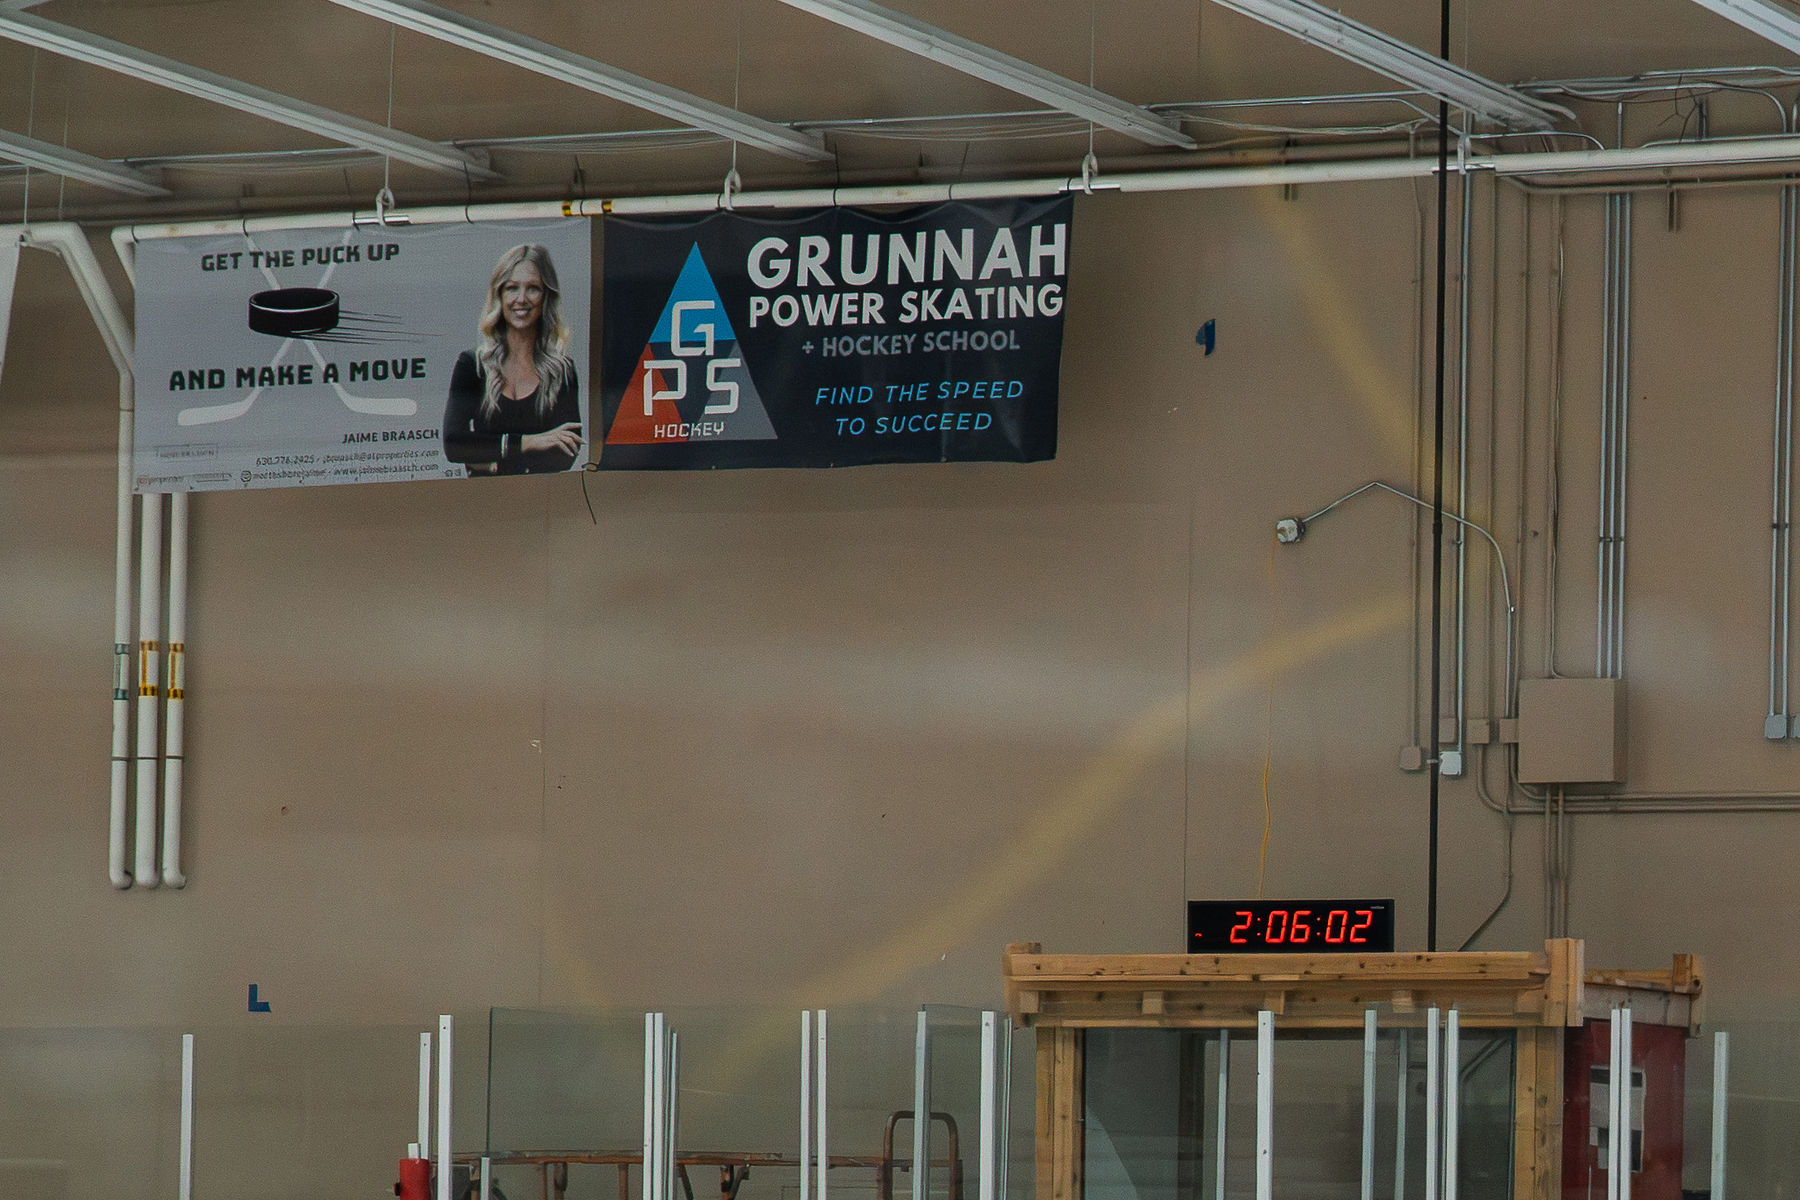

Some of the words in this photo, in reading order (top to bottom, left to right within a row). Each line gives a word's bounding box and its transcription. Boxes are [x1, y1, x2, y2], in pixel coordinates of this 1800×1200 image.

[201, 253, 242, 271] GET
[249, 250, 295, 268] THE
[302, 245, 360, 266] PUCK
[368, 243, 400, 262] UP
[747, 223, 1067, 290] GRUNNAH
[749, 293, 885, 328] POWER
[899, 283, 1063, 323] SKATING
[671, 301, 715, 357] G
[822, 334, 918, 357] HOCKEY
[923, 330, 1020, 352] SCHOOL
[169, 367, 225, 391] AND
[236, 363, 313, 388] MAKE
[324, 363, 339, 384] A
[349, 357, 427, 382] MOVE
[815, 387, 874, 406] FIND
[885, 384, 929, 402] THE
[937, 380, 1024, 400] SPEED
[342, 430, 379, 445] JAIME
[382, 428, 440, 443] BRAASCH
[654, 422, 725, 439] HOCKEY
[836, 418, 865, 436] TO
[875, 413, 993, 434] SUCCEED
[1230, 910, 1373, 944] 2:06:02
